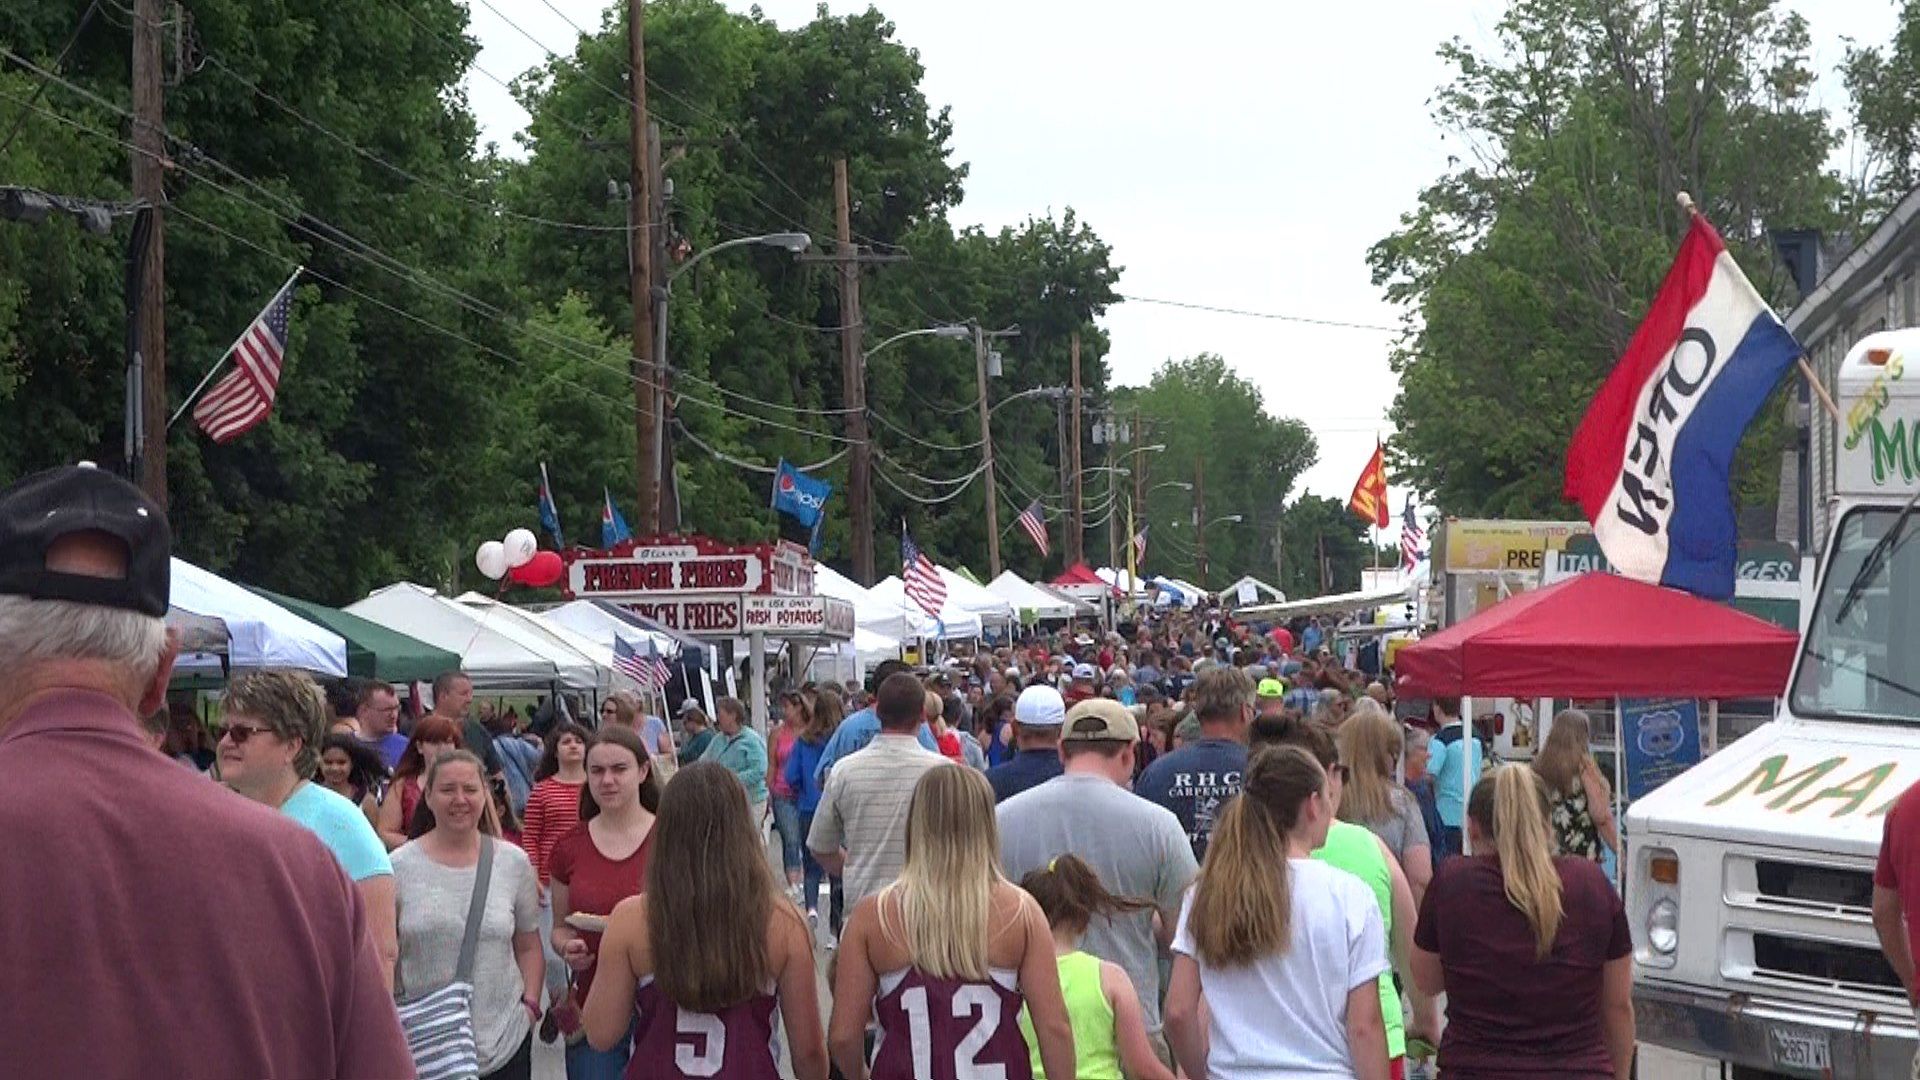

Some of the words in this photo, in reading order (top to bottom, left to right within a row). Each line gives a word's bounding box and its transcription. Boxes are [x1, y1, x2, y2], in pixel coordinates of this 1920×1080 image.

[583, 562, 675, 592] FRENCH
[679, 559, 747, 589] FRIES
[1737, 560, 1794, 581] GES
[682, 602, 738, 630] FRIES
[746, 609, 771, 625] FRESH
[777, 609, 824, 625] POTATOES
[752, 600, 765, 608] WE
[769, 600, 785, 608] USE
[789, 599, 814, 608] ONLY
[675, 1003, 726, 1078] 5
[900, 984, 1008, 1080] 12
